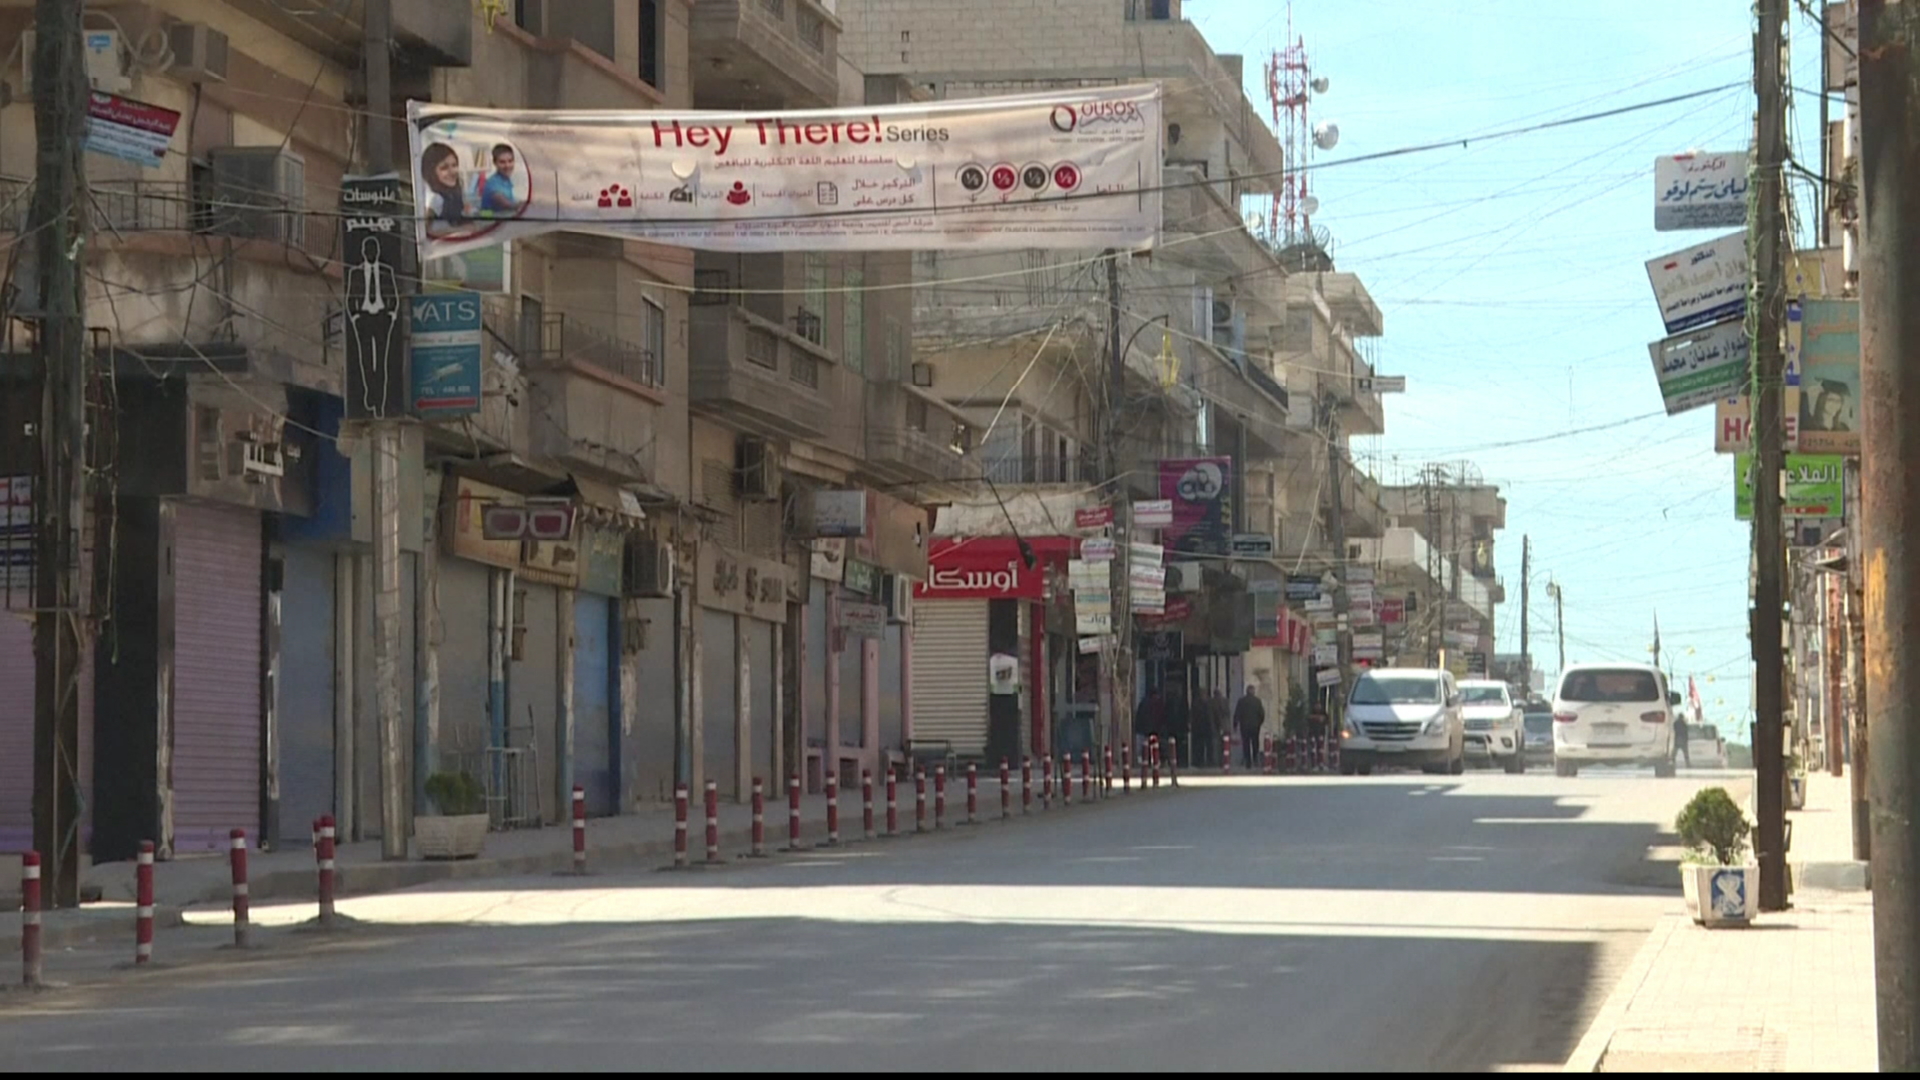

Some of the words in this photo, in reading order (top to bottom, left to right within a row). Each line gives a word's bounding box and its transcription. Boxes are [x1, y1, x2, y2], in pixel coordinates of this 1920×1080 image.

[1081, 101, 1136, 117] OUSOS
[651, 119, 733, 156] Hey
[746, 115, 883, 146] There!
[886, 125, 950, 143] Series
[344, 187, 395, 204] ملبوسات
[921, 561, 1018, 594] أوسكار
